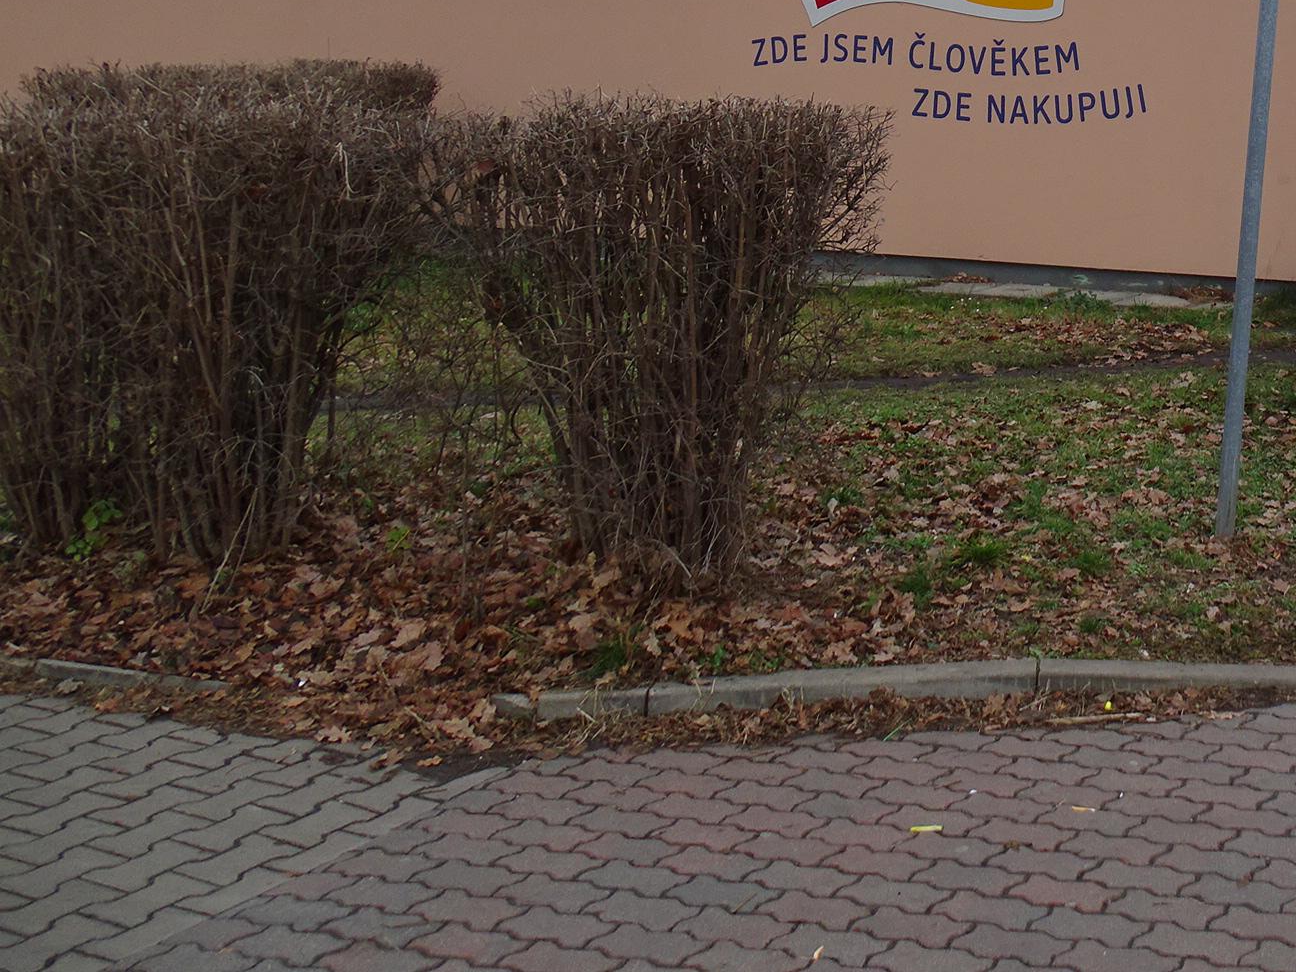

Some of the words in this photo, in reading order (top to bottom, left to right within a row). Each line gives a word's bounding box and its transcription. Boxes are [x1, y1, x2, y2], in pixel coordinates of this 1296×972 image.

[751, 33, 808, 67] ZDE
[820, 33, 894, 66] JSEM
[908, 32, 1080, 76] ČLOVĚKEM
[911, 88, 972, 122] ZDE
[987, 83, 1147, 125] NAKUPUJI
